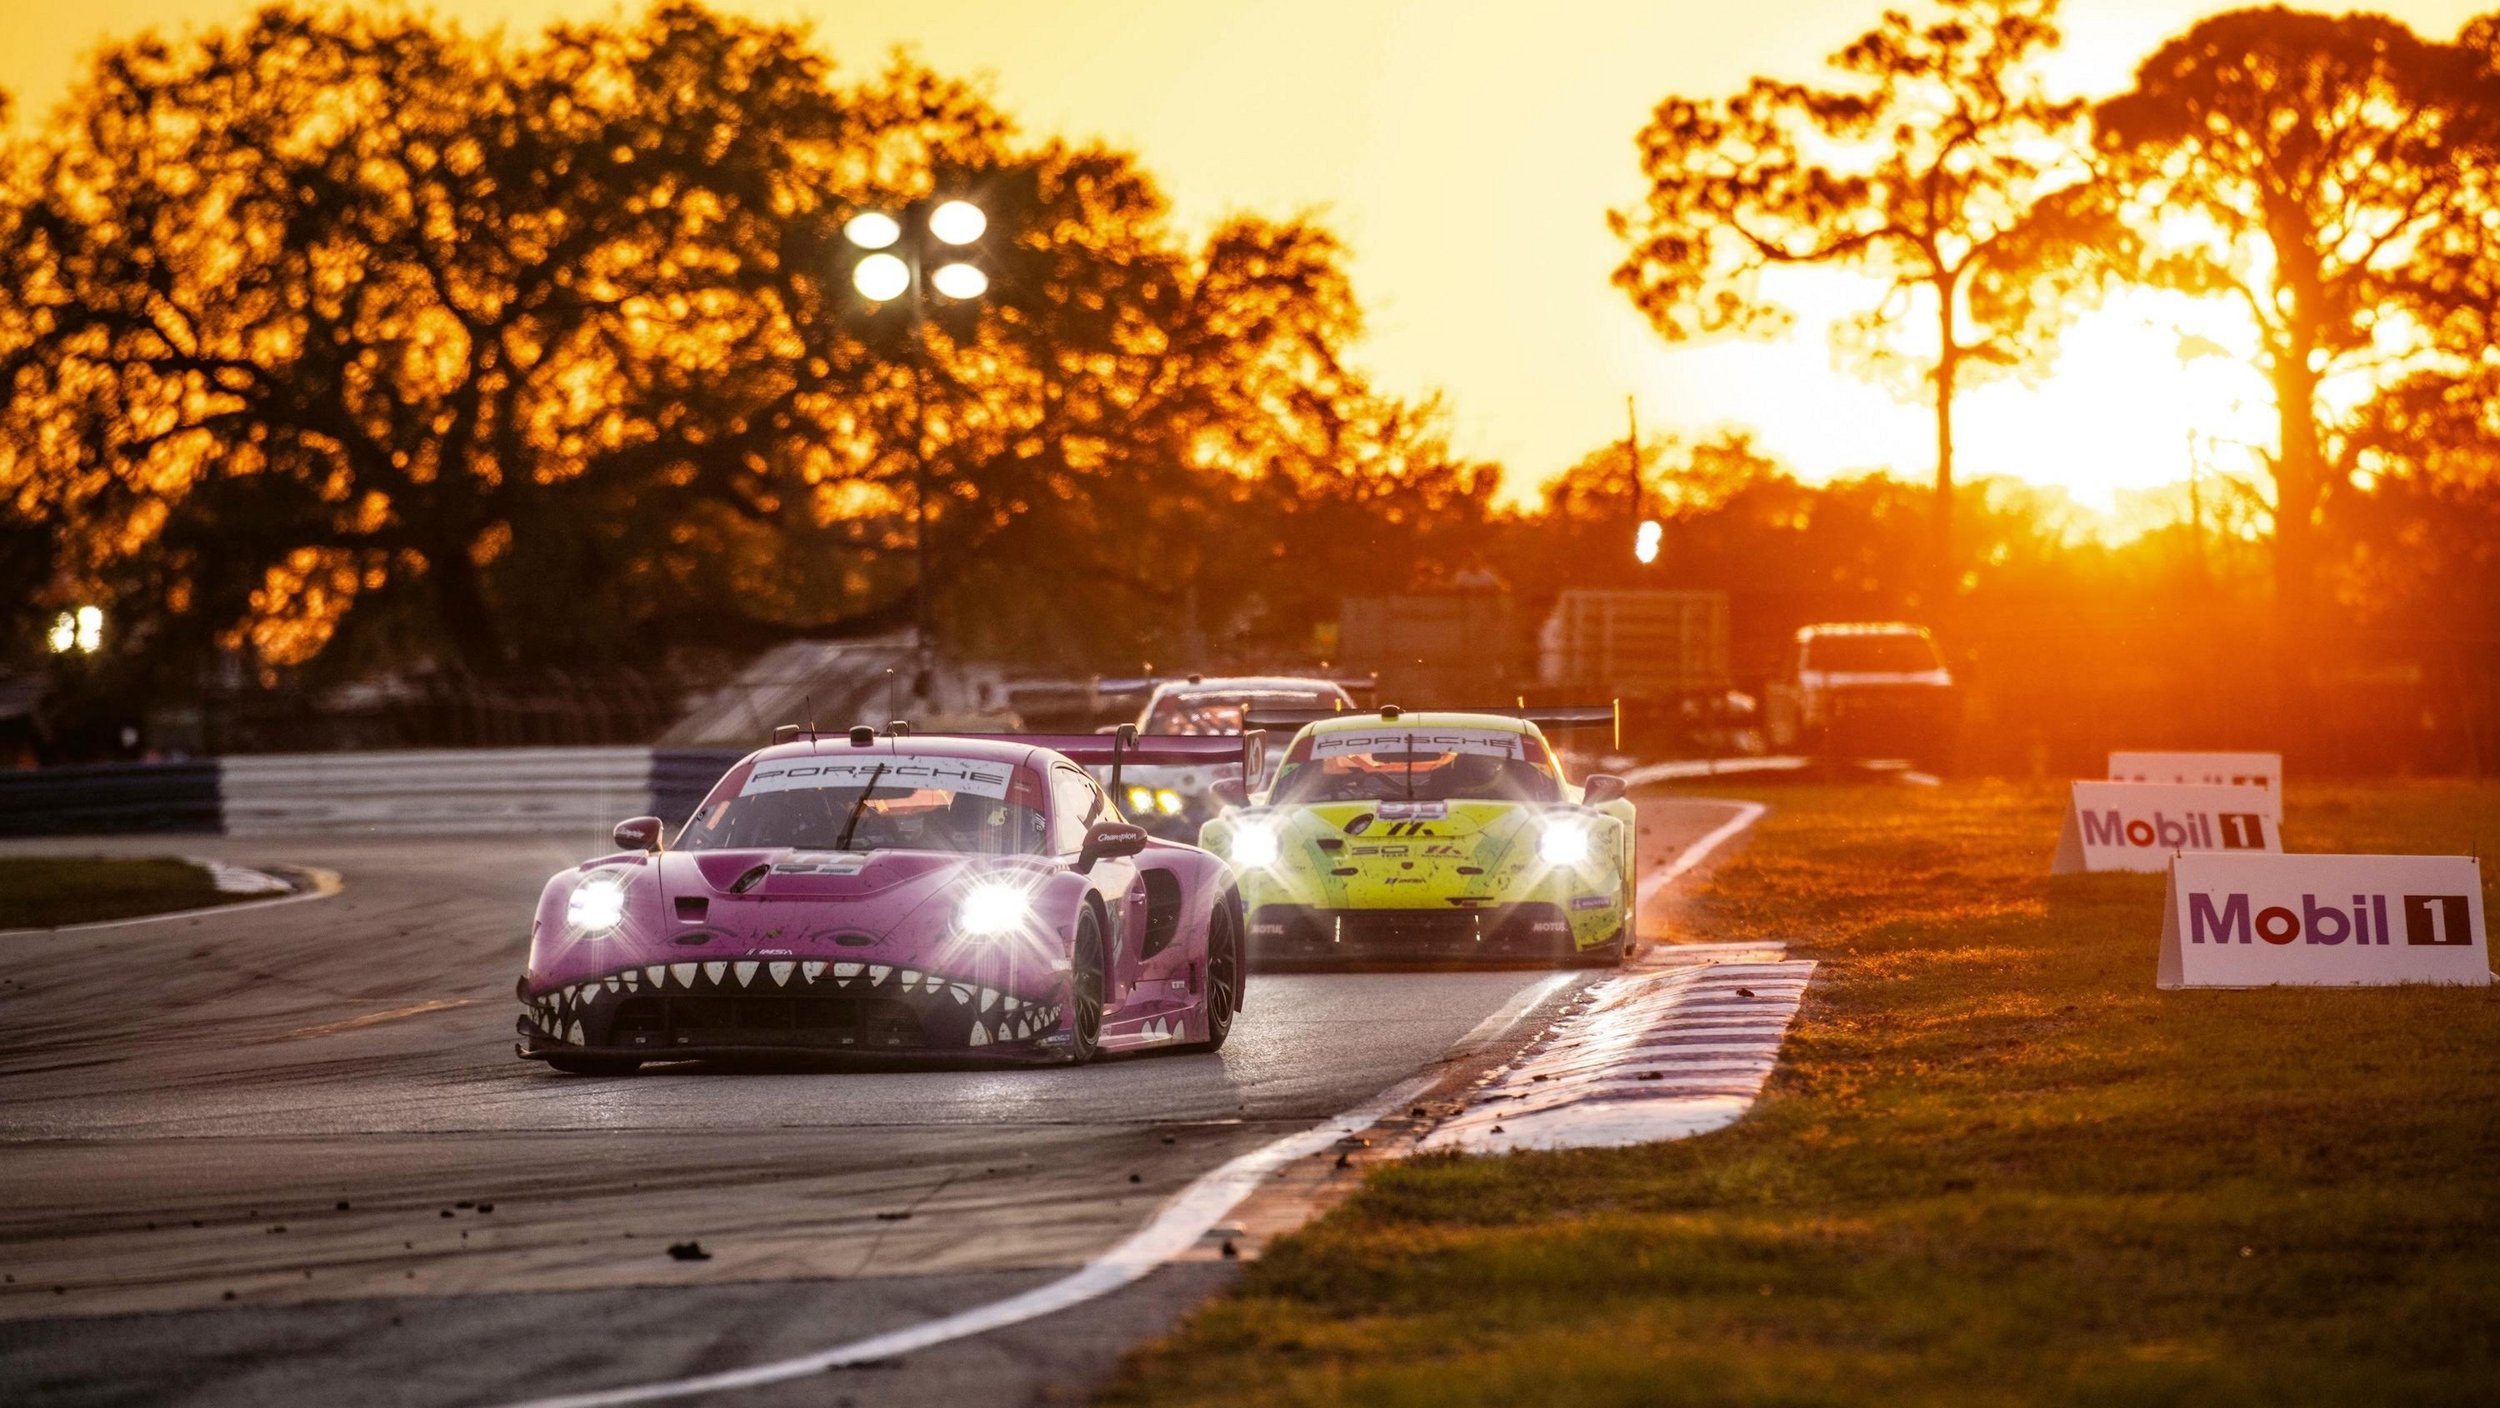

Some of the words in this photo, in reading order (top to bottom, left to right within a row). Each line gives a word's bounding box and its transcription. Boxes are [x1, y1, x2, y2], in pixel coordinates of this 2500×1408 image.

[1317, 735, 1517, 751] PORSCHE
[751, 765, 1004, 786] PORSCHE
[2081, 810, 2213, 848] Mobil
[1097, 833, 1137, 842] Champion
[1532, 922, 1566, 932] MOTUL
[2188, 892, 2390, 946] Mobil
[1250, 924, 1284, 935] MOTUL
